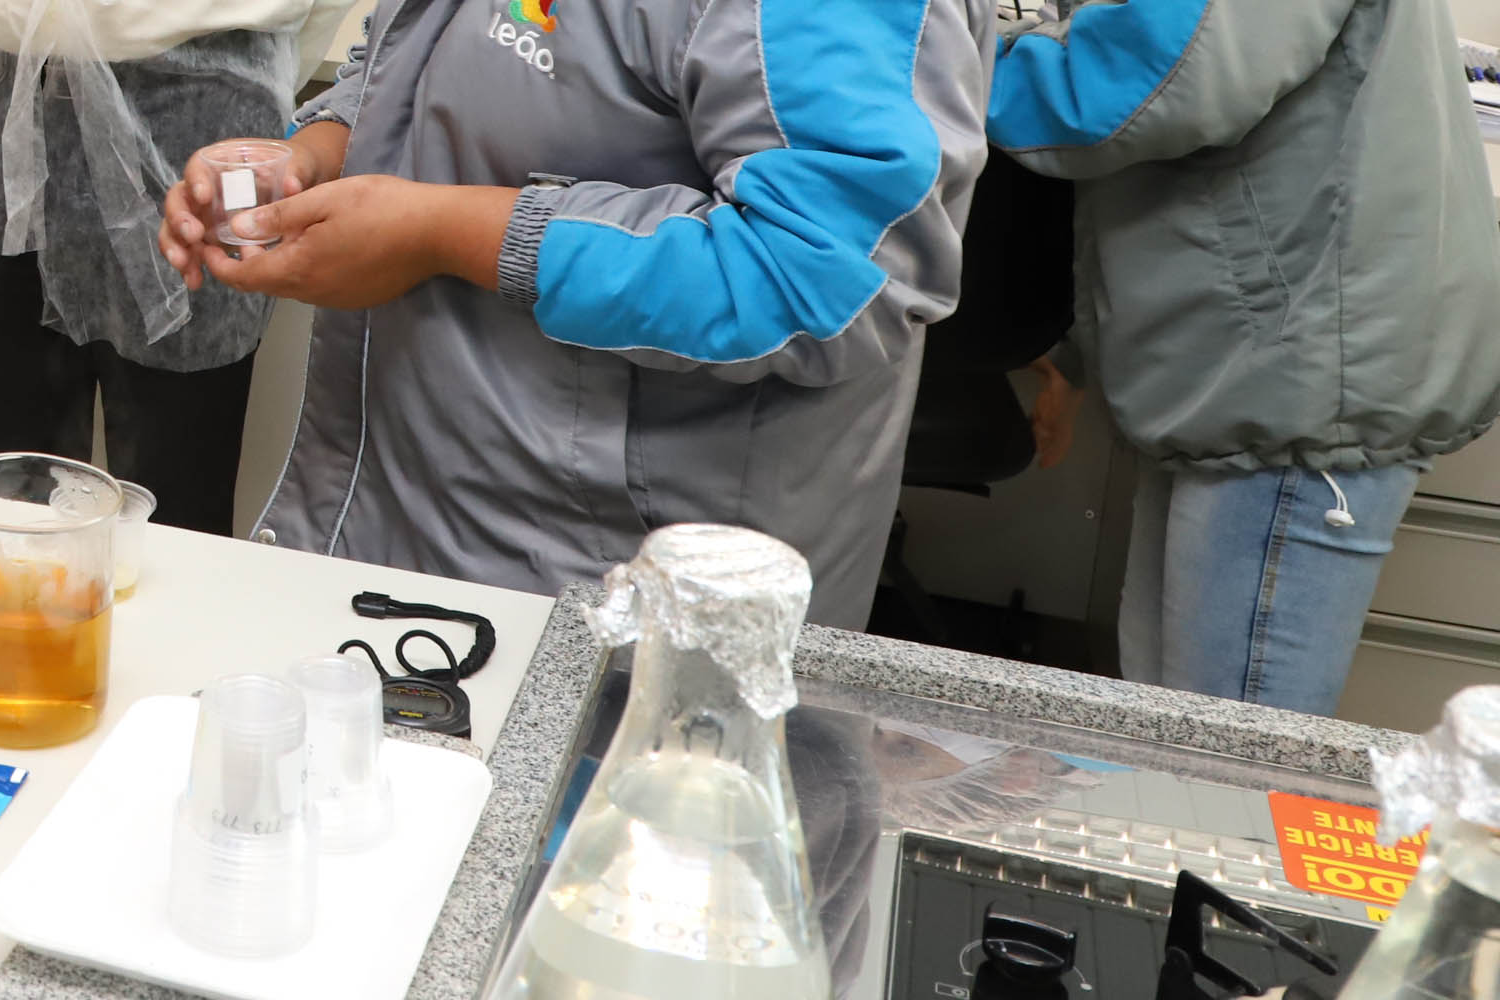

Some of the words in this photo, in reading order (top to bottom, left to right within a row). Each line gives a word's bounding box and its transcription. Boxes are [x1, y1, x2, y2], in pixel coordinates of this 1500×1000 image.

[488, 12, 554, 72] leão
[1283, 826, 1420, 868] ERFÍCIE
[1304, 862, 1407, 900] DO!
